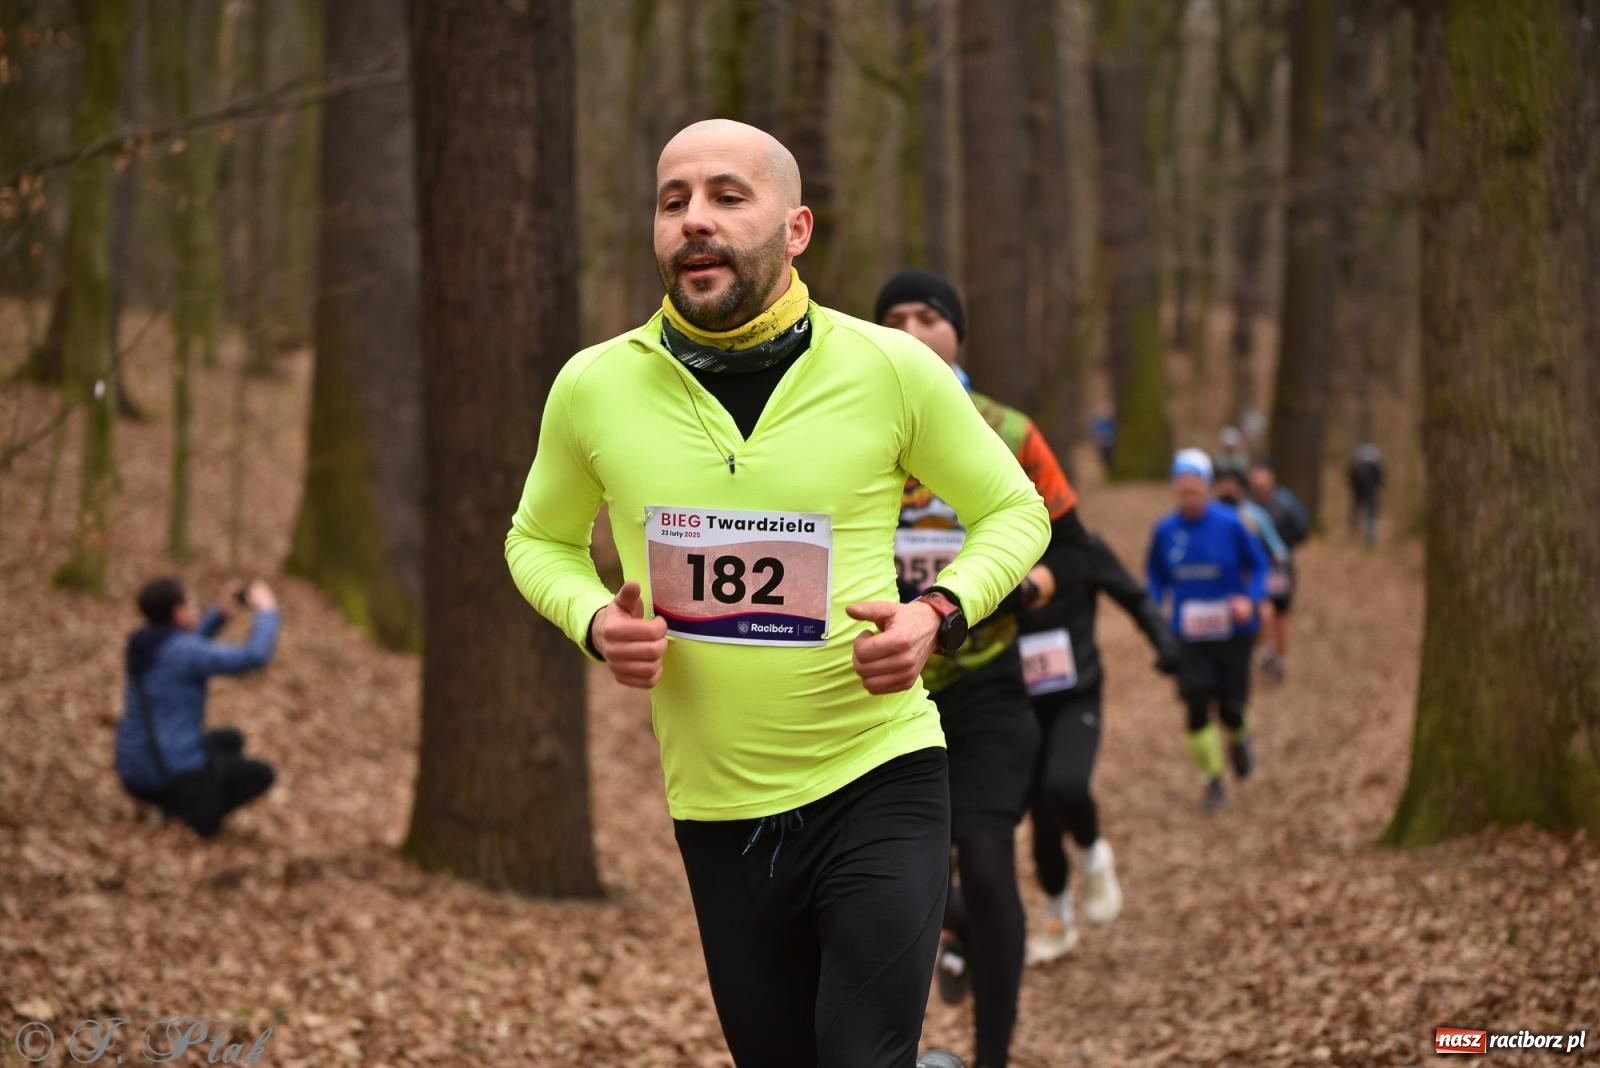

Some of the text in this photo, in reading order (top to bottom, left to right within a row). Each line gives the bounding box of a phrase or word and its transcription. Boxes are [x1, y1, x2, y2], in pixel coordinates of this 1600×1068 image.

[661, 512, 815, 533] BIEG Twardziela
[670, 530, 683, 539] luty
[687, 553, 785, 605] 182
[751, 622, 794, 634] Racibórz
